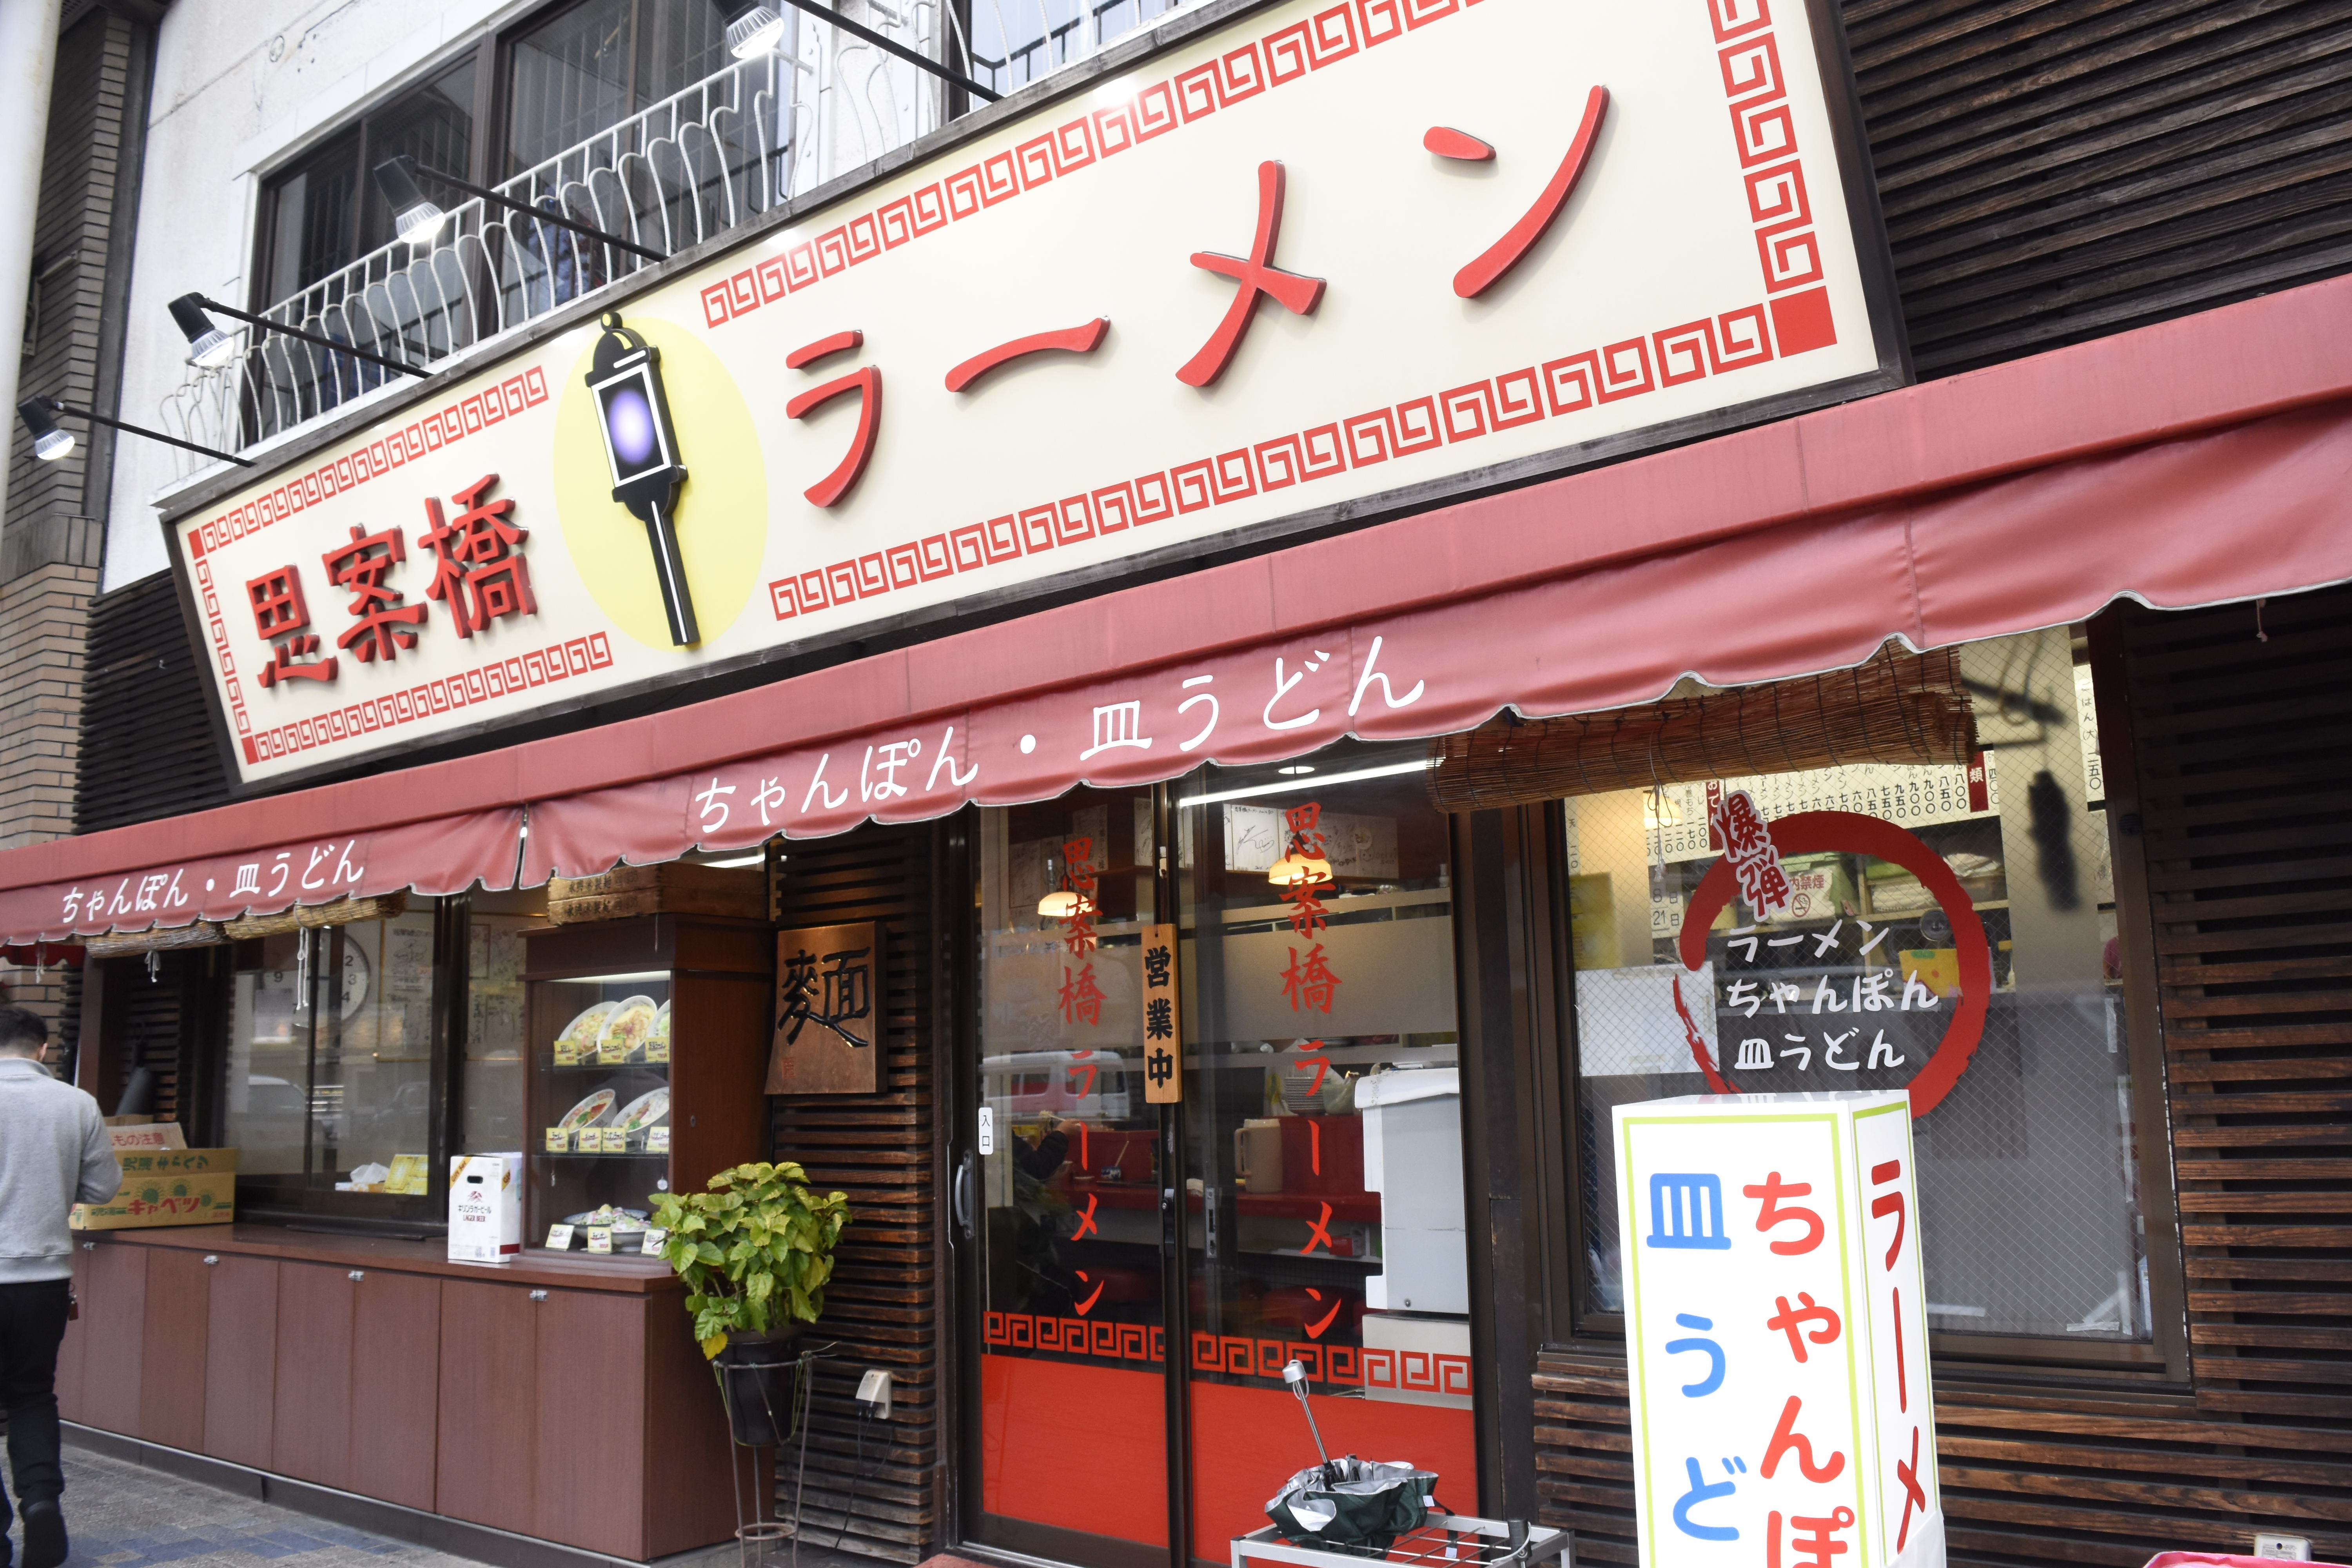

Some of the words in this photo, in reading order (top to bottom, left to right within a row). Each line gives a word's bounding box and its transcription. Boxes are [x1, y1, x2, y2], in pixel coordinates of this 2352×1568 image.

[246, 473, 537, 689] 思案橋
[786, 85, 1611, 509] ラーメン
[1728, 919, 1889, 962] ラーメン
[1145, 945, 1173, 1089] 営業中
[1726, 969, 1938, 1018] ちゃんぽん
[1281, 802, 1342, 1339] 思案橋ラーメン
[1735, 1027, 1905, 1071] 皿うどん
[1057, 837, 1107, 1316] 思案橋ラーメン
[112, 1132, 165, 1146] もの注意
[982, 1115, 990, 1147] 入口
[127, 1198, 201, 1215] キャベツ
[1646, 1173, 1747, 1541] 皿うど
